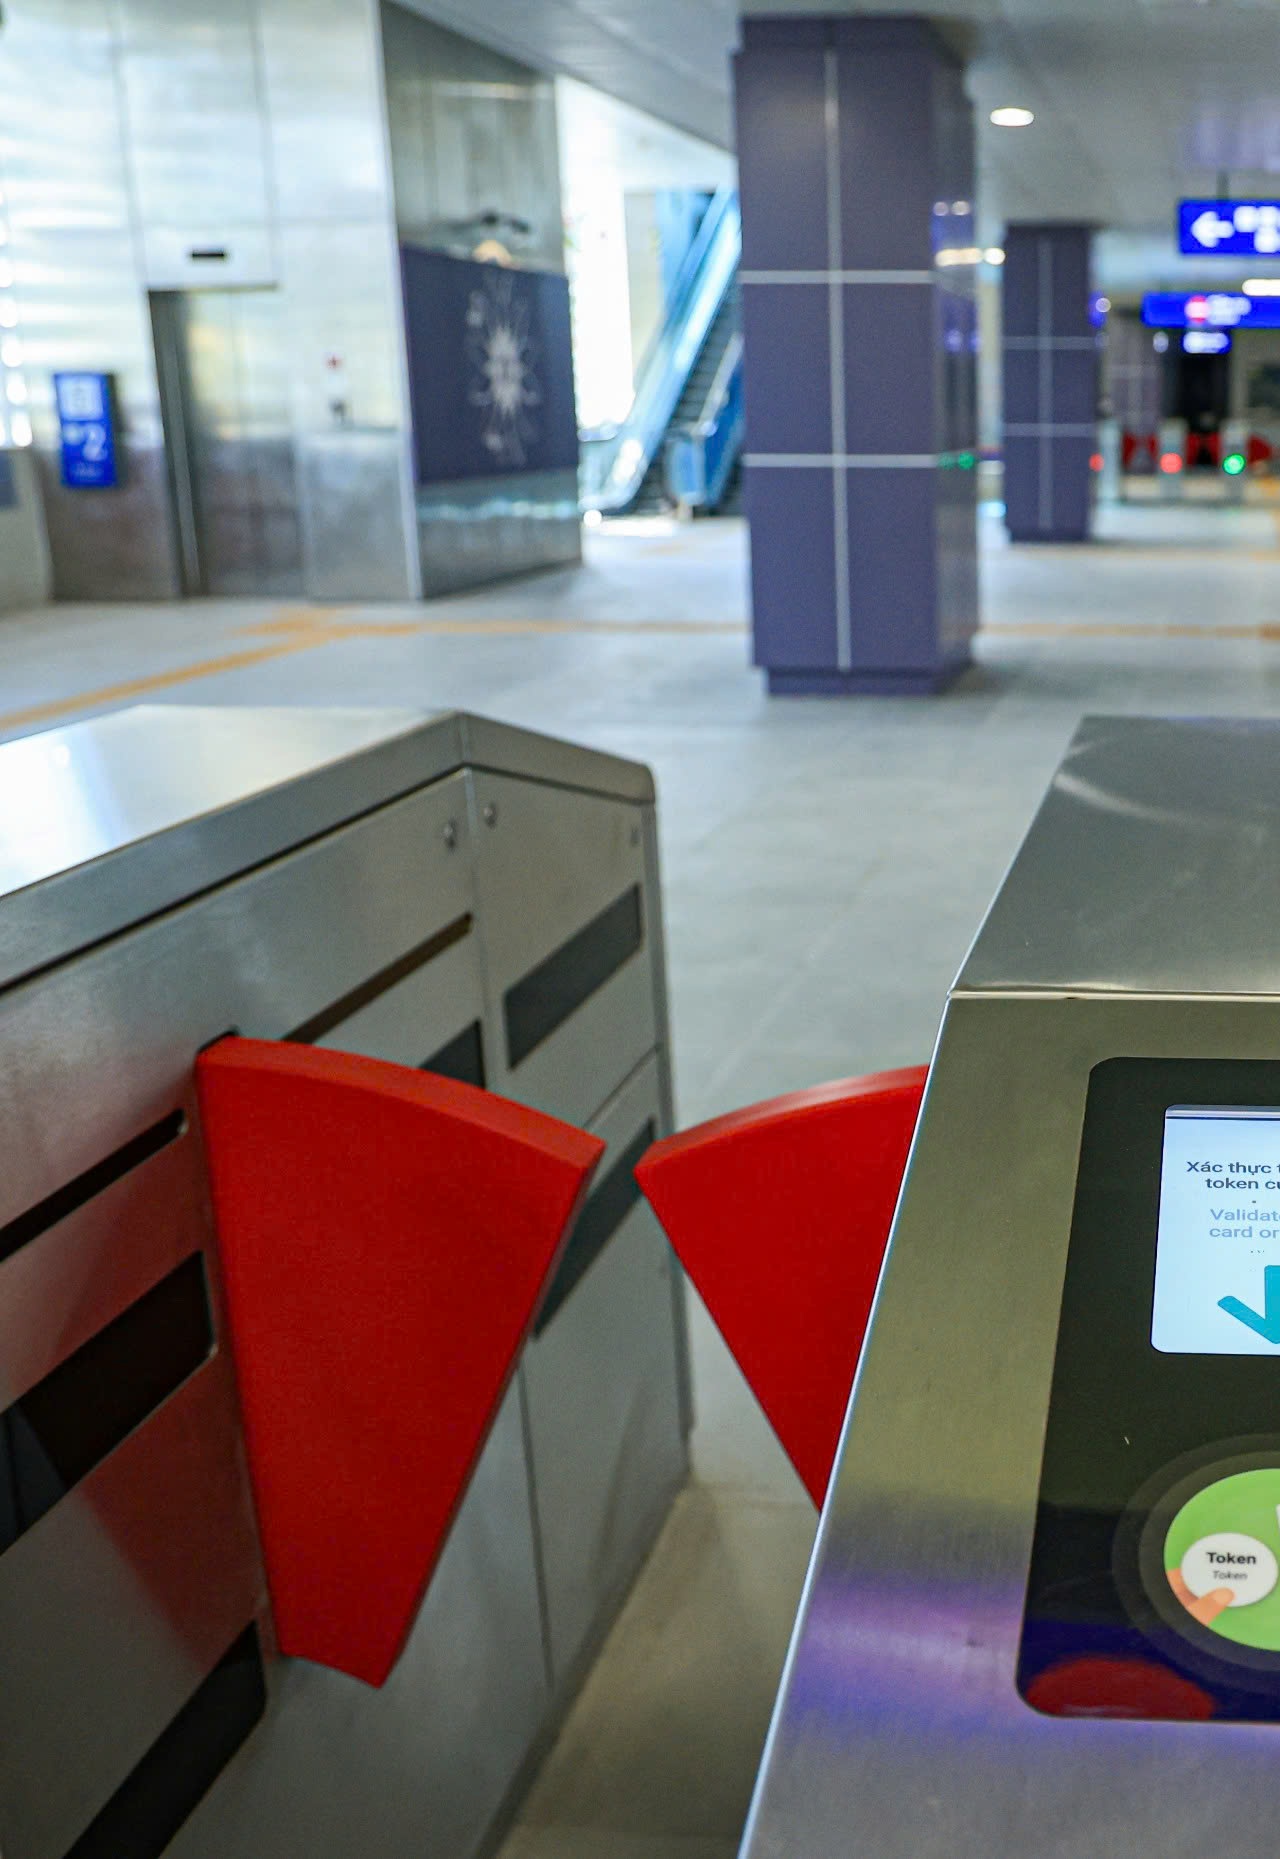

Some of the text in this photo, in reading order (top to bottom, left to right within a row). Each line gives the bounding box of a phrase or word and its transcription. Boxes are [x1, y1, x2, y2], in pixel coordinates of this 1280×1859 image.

[1186, 1161, 1223, 1173] Xác
[1228, 1161, 1272, 1175] thực
[1205, 1177, 1259, 1189] token
[1209, 1226, 1253, 1238] card
[1259, 1229, 1280, 1239] or
[1206, 1551, 1257, 1565] Token
[1212, 1570, 1248, 1581] Token
